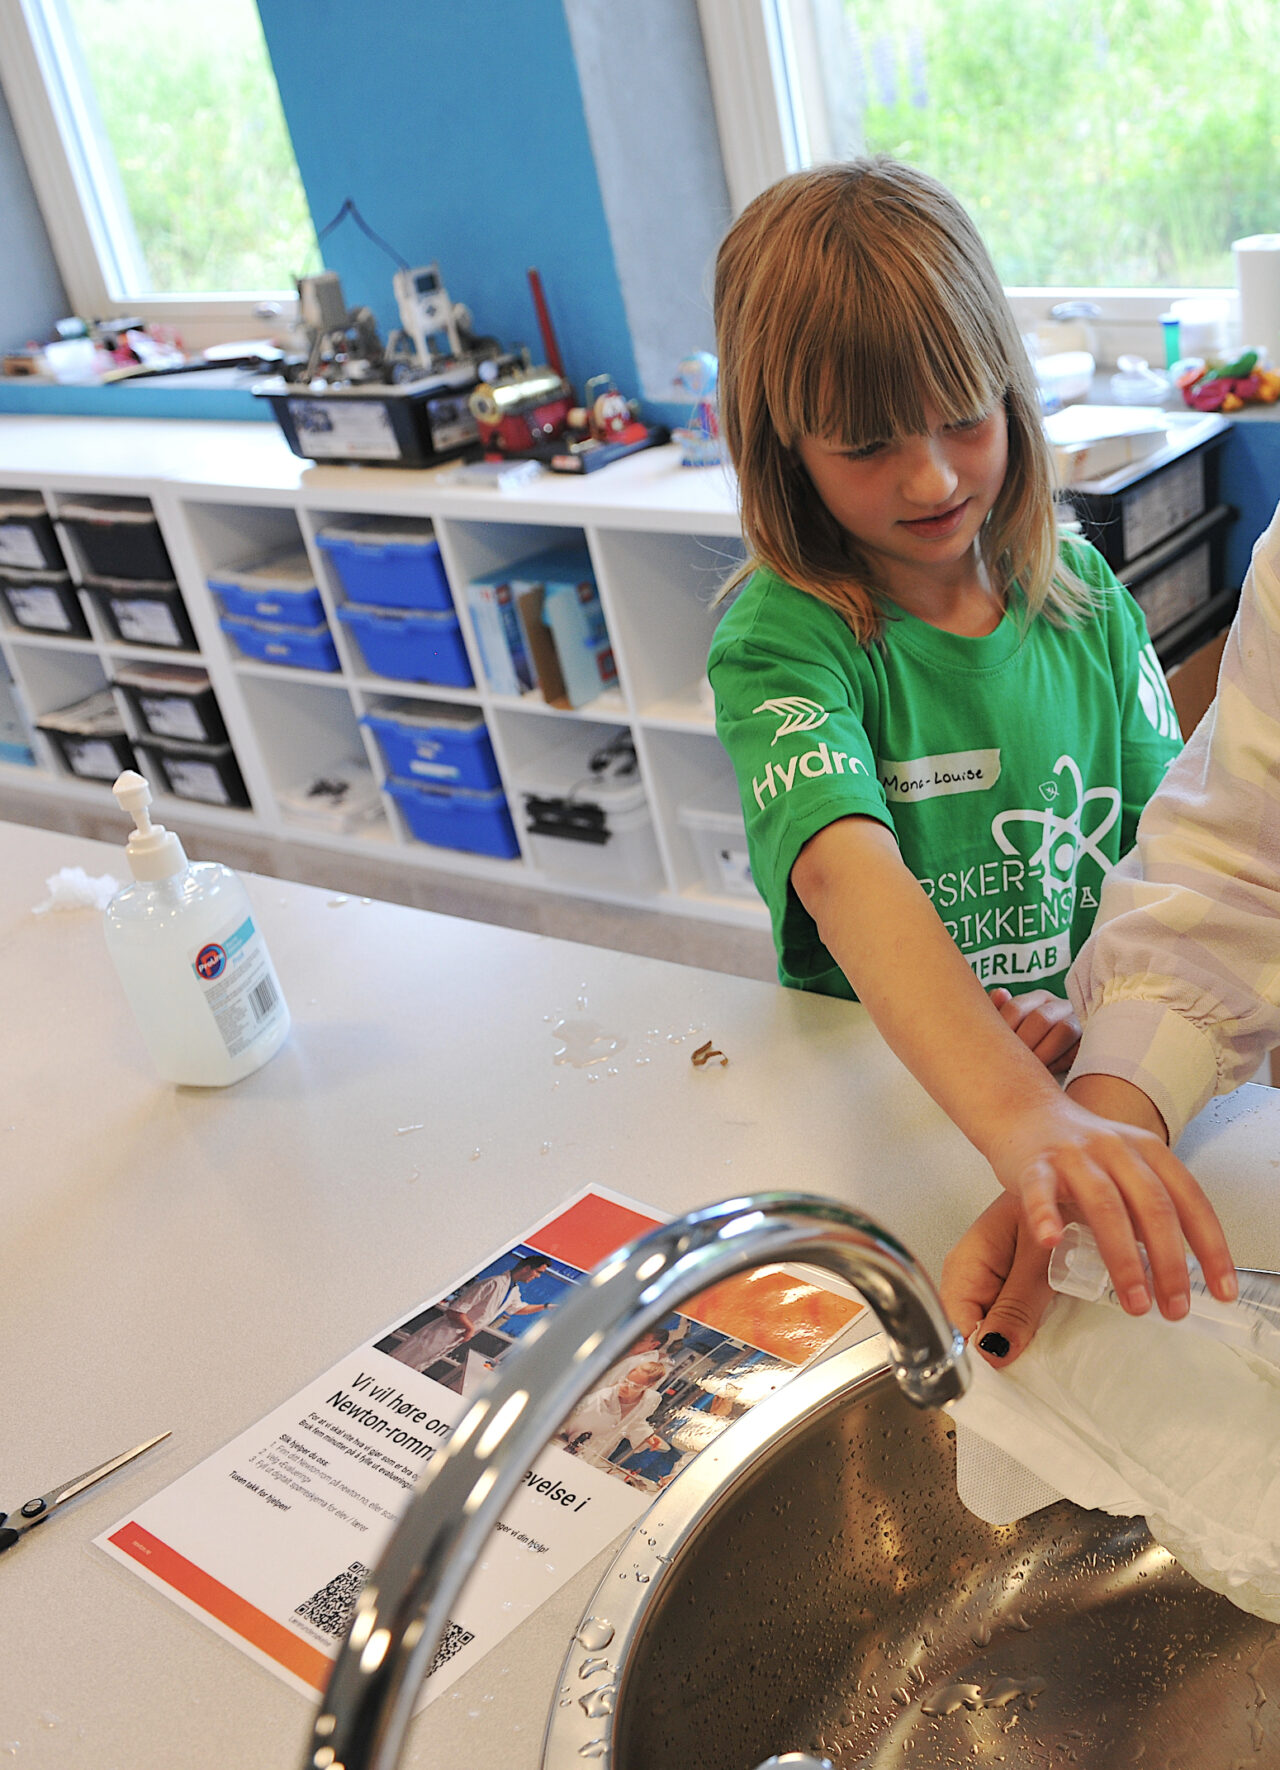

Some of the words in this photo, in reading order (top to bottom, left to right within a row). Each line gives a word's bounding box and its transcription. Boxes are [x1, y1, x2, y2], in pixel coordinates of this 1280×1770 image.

[971, 945, 1058, 980] ERLAB
[325, 1390, 436, 1461] Newton-romm
[352, 1373, 375, 1390] Vi
[368, 1387, 395, 1402] vil
[387, 1394, 427, 1422] høre
[521, 1470, 577, 1506] evelse
[574, 1497, 591, 1512] i
[378, 1467, 413, 1488] evaluerings
